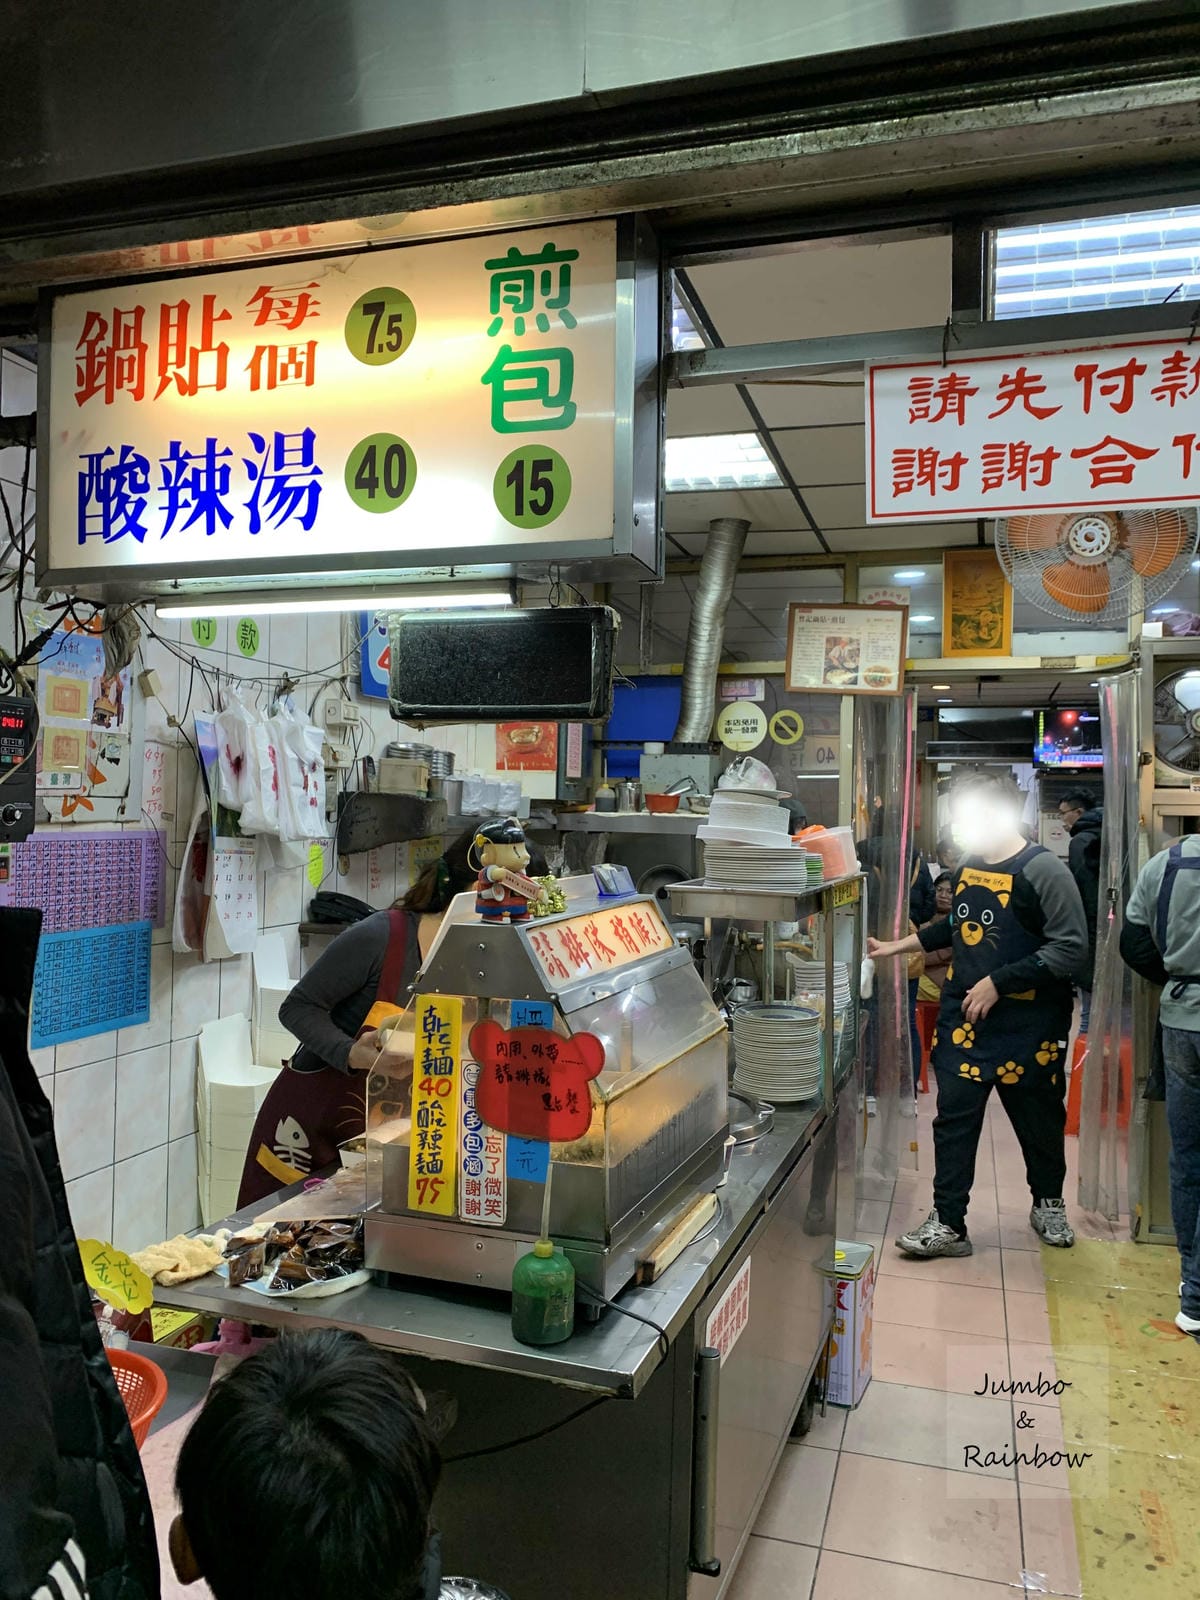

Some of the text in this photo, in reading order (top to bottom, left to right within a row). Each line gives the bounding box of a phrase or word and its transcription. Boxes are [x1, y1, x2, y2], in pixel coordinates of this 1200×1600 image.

[362, 301, 403, 356] 7.5
[481, 242, 580, 434] 煎包
[77, 427, 407, 546] 酸辣湯 40
[506, 458, 554, 517] 15
[418, 1077, 453, 1098] 40
[414, 1177, 446, 1206] 75
[484, 1131, 502, 1218] 忘了微笑
